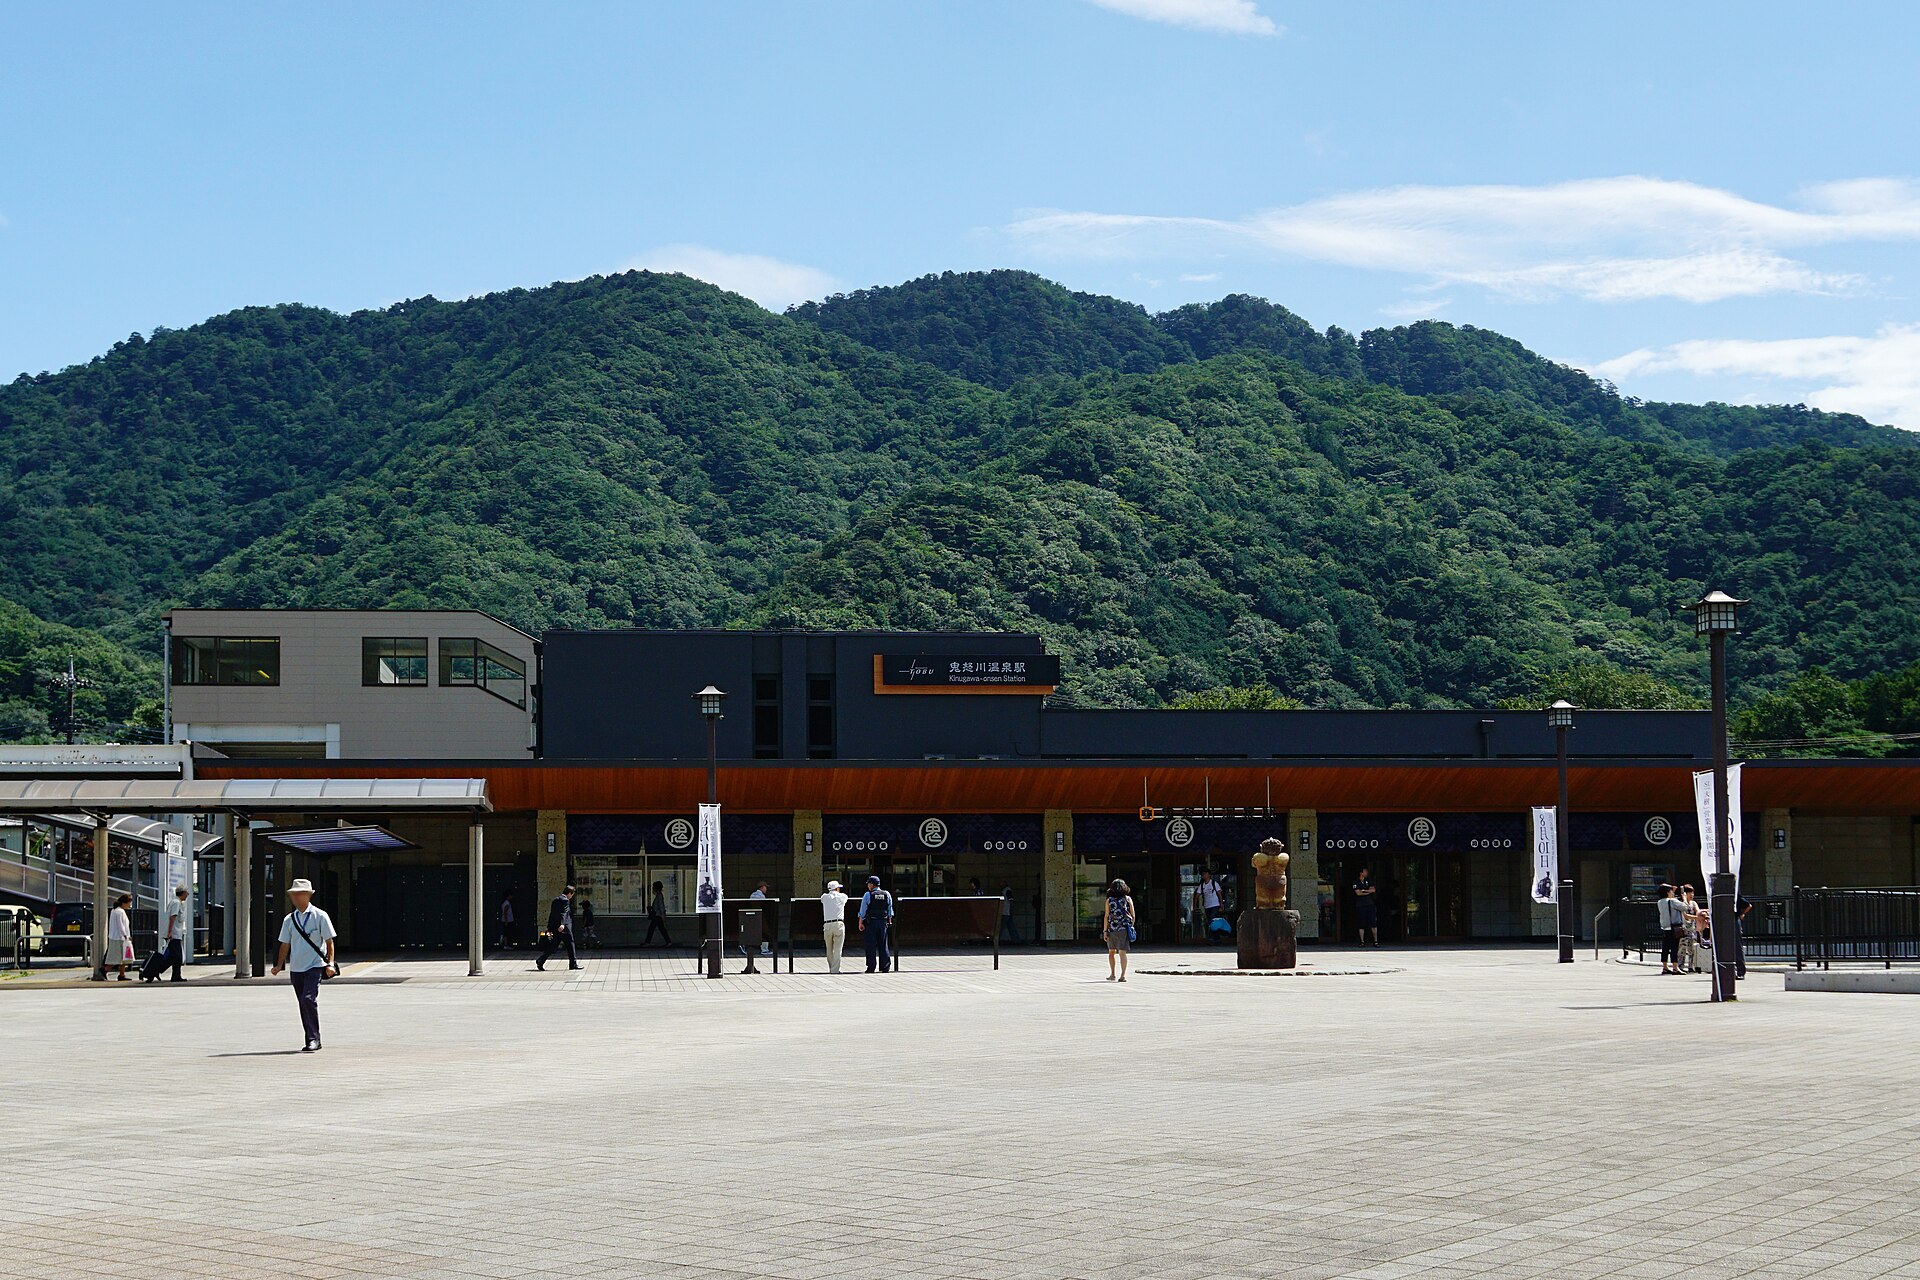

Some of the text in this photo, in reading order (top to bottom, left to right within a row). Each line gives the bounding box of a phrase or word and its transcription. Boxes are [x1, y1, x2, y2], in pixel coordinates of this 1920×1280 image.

[949, 661, 1026, 673] 鬼怒川温泉駅
[949, 674, 1026, 683] Kinugawa-onsen Station
